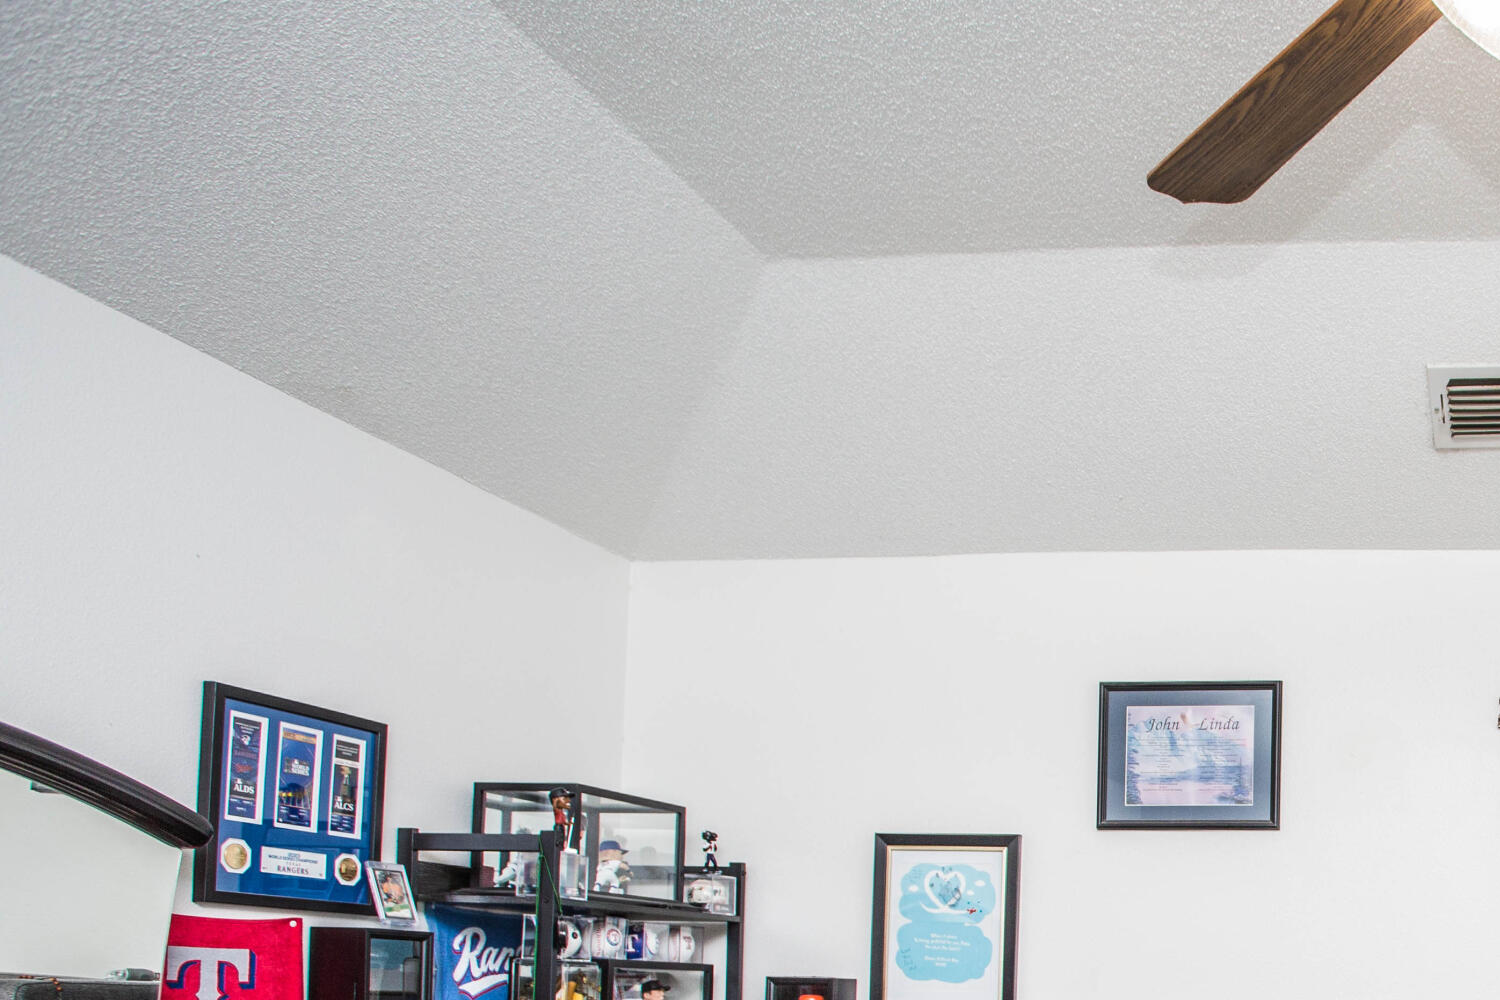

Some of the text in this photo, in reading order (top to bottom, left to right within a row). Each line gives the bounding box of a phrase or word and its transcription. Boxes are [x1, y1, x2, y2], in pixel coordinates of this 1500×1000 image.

[1146, 716, 1180, 733] John
[1198, 715, 1240, 731] Linda
[334, 801, 354, 811] ALCS
[277, 865, 309, 875] RANGERS
